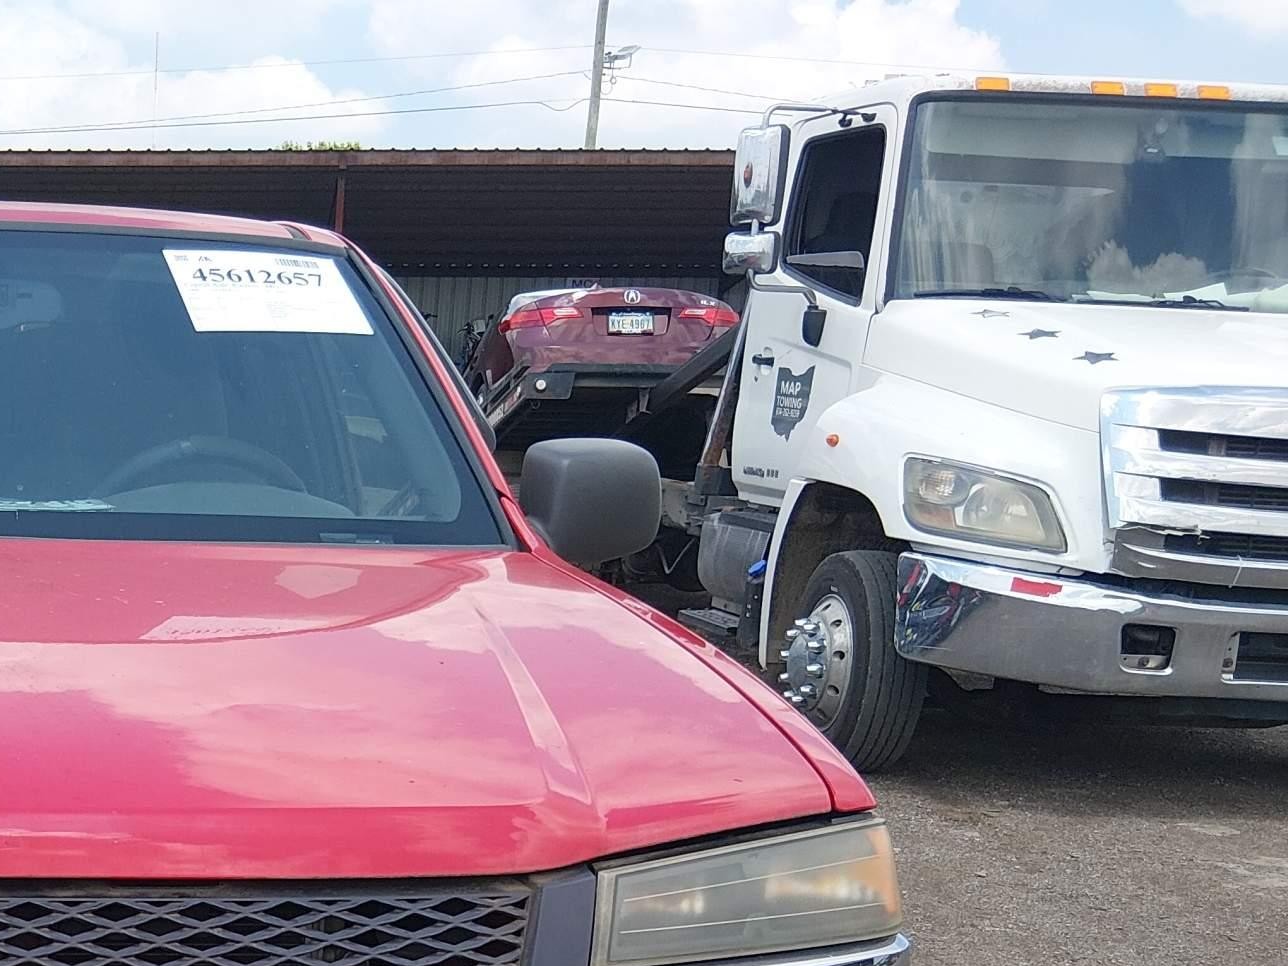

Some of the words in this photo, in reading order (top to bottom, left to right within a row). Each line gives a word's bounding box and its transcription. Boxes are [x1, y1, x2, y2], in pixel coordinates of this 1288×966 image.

[192, 267, 322, 288] 45612657
[610, 318, 627, 330] KYE
[780, 380, 802, 396] MAP
[776, 395, 803, 409] TOWING
